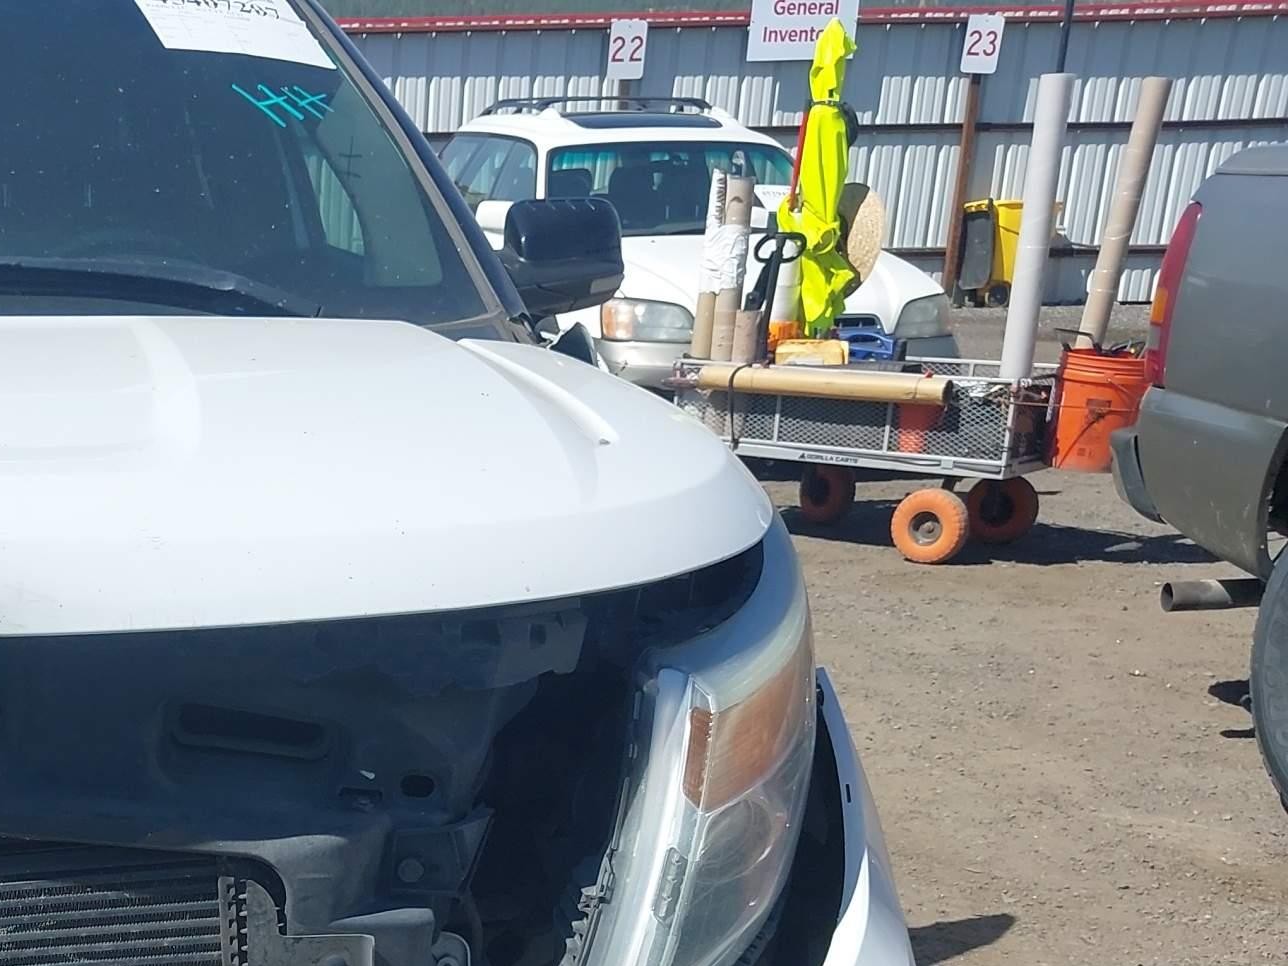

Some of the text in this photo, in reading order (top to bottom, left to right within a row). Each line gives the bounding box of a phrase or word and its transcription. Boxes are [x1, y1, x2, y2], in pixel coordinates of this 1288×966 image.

[160, 0, 280, 19] 407207
[774, 0, 839, 15] General
[763, 26, 825, 42] Invento
[967, 30, 998, 56] 23
[611, 36, 644, 62] 22
